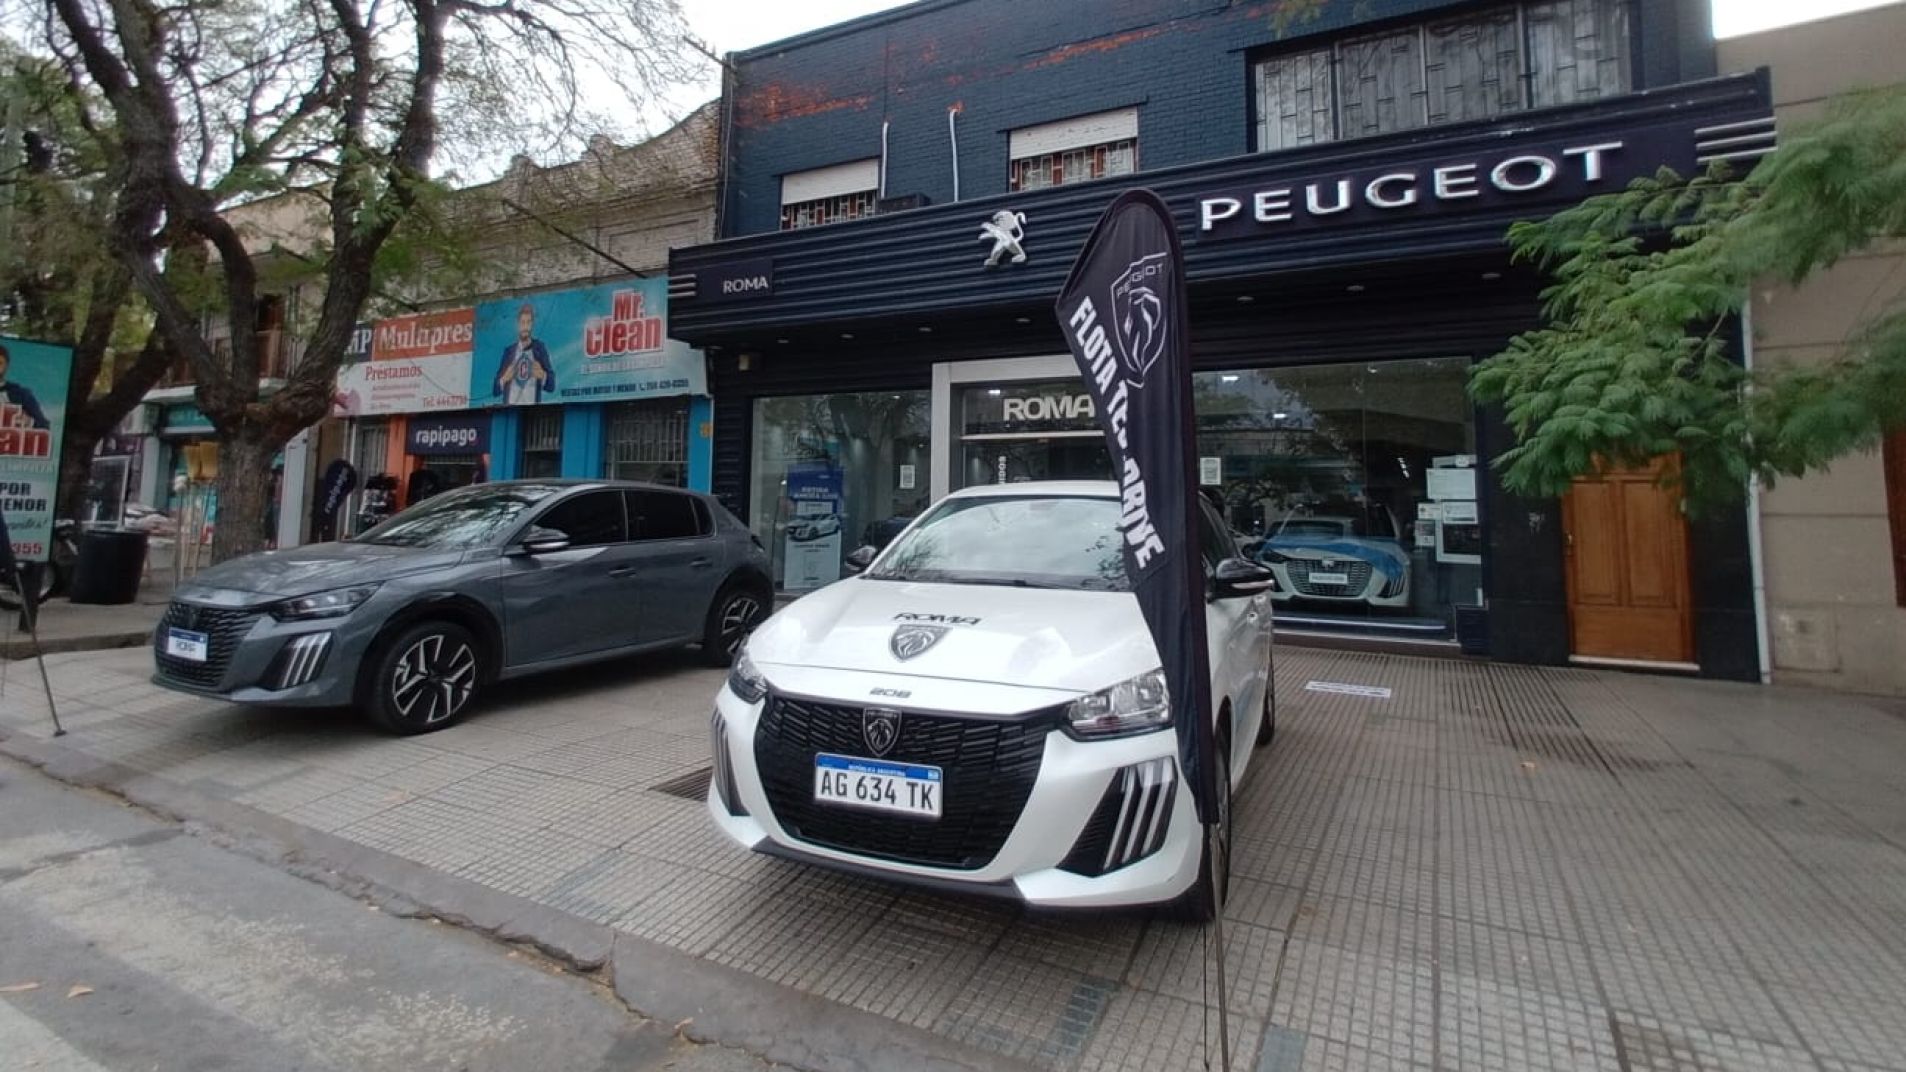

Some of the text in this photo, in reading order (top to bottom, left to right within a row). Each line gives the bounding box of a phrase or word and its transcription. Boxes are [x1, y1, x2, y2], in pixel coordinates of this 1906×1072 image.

[1200, 140, 1623, 231] PEUGEOT
[722, 276, 769, 294] ROMA
[614, 291, 645, 321] Mr.
[1069, 296, 1118, 395] FLOTA
[1003, 394, 1096, 421] ROMA
[415, 425, 478, 447] rapipago
[0, 482, 31, 496] POR
[0, 498, 47, 511] ENOR
[894, 612, 982, 626] ROMA
[869, 687, 912, 699] 208
[821, 769, 934, 811] AG 634 TK
